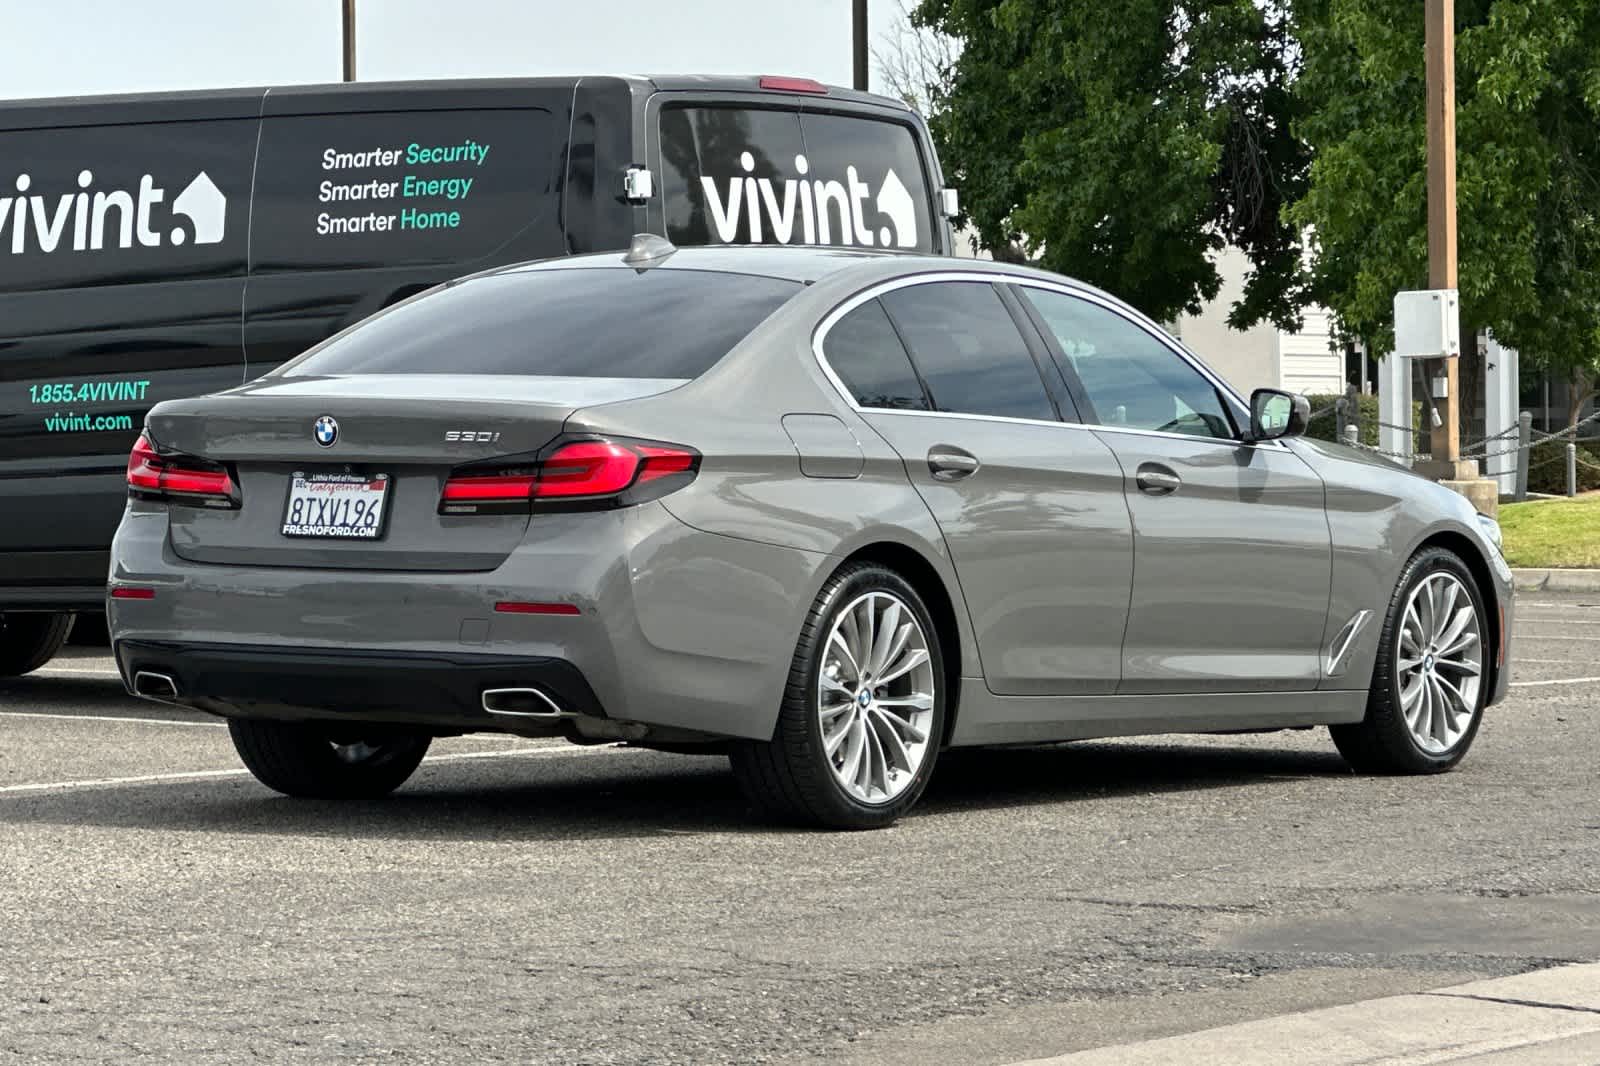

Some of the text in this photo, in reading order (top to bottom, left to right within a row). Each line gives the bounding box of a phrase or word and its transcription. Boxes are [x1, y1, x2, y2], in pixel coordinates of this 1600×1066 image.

[321, 139, 490, 170] Smarter Security
[318, 176, 473, 202] Smarter Energy
[316, 208, 461, 235] Smarter Home
[29, 381, 151, 404] 1.855.4VIVINT
[44, 411, 133, 432] vivint.com
[290, 497, 379, 527] 8TXV196
[282, 524, 377, 537] FRESNOFORD.COM
